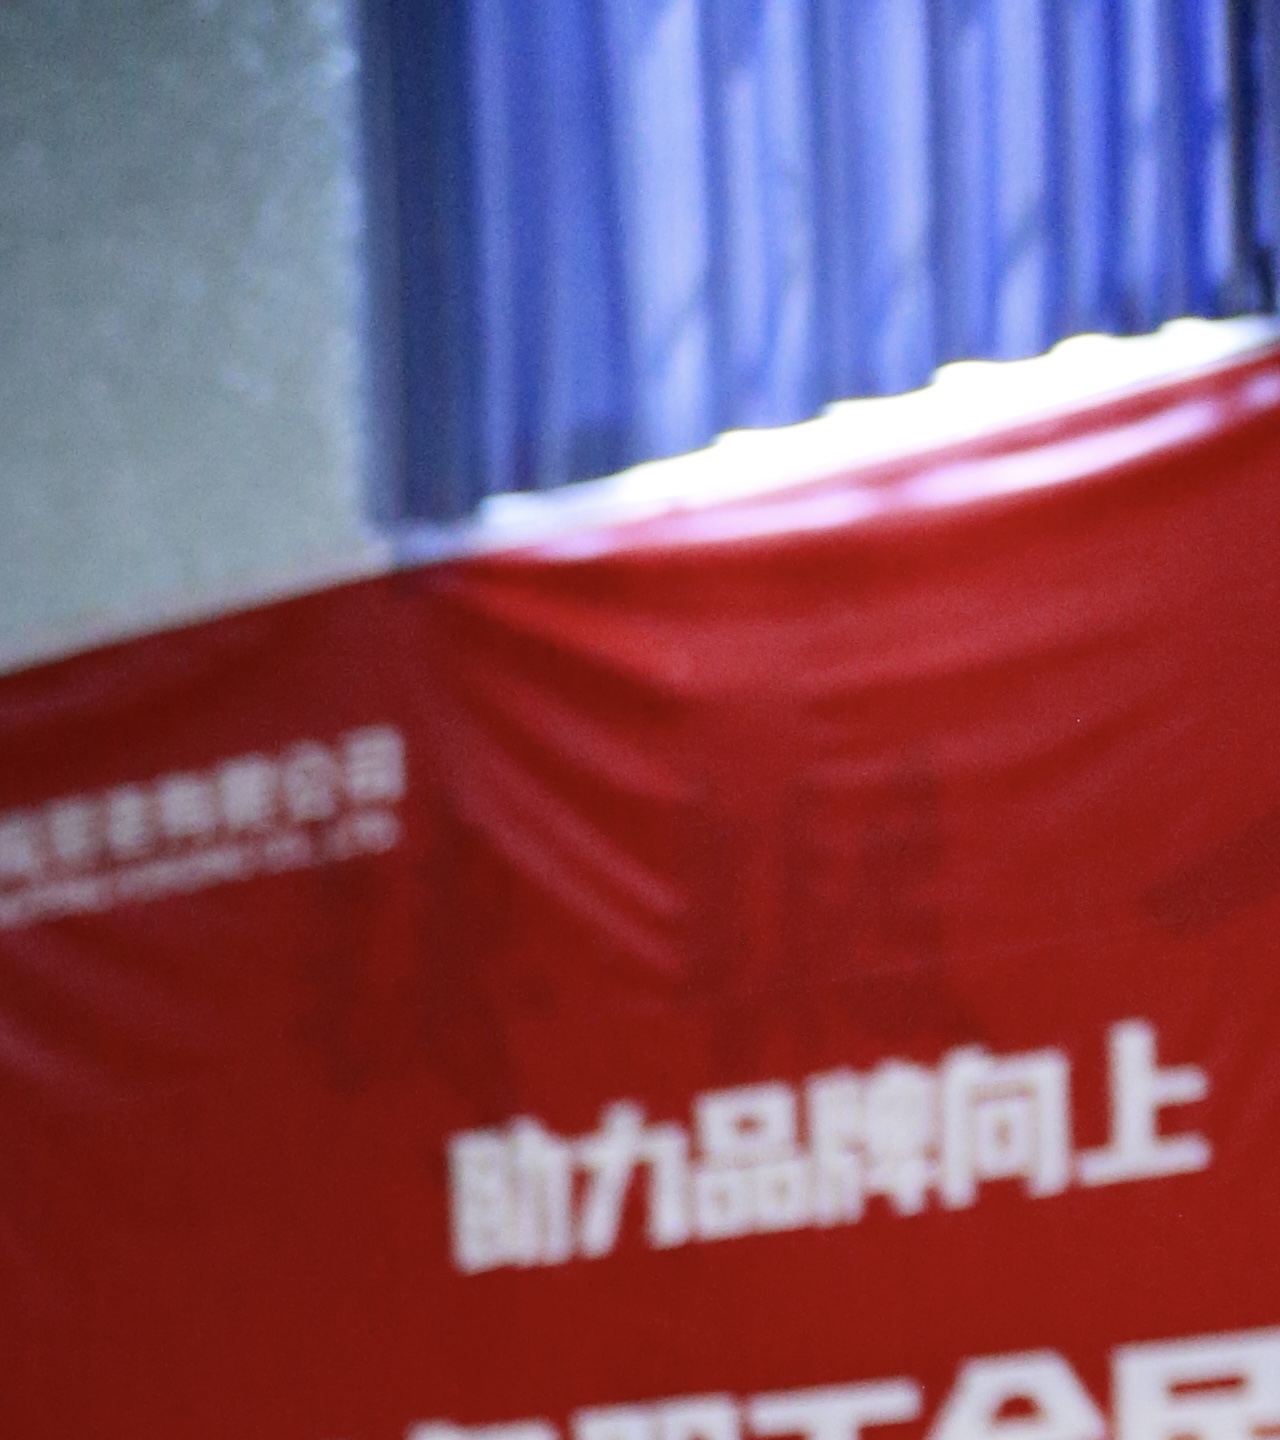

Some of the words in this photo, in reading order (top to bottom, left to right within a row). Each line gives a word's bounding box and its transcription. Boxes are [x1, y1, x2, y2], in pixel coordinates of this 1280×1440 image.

[451, 1021, 1210, 1270] 助力品牌向上
